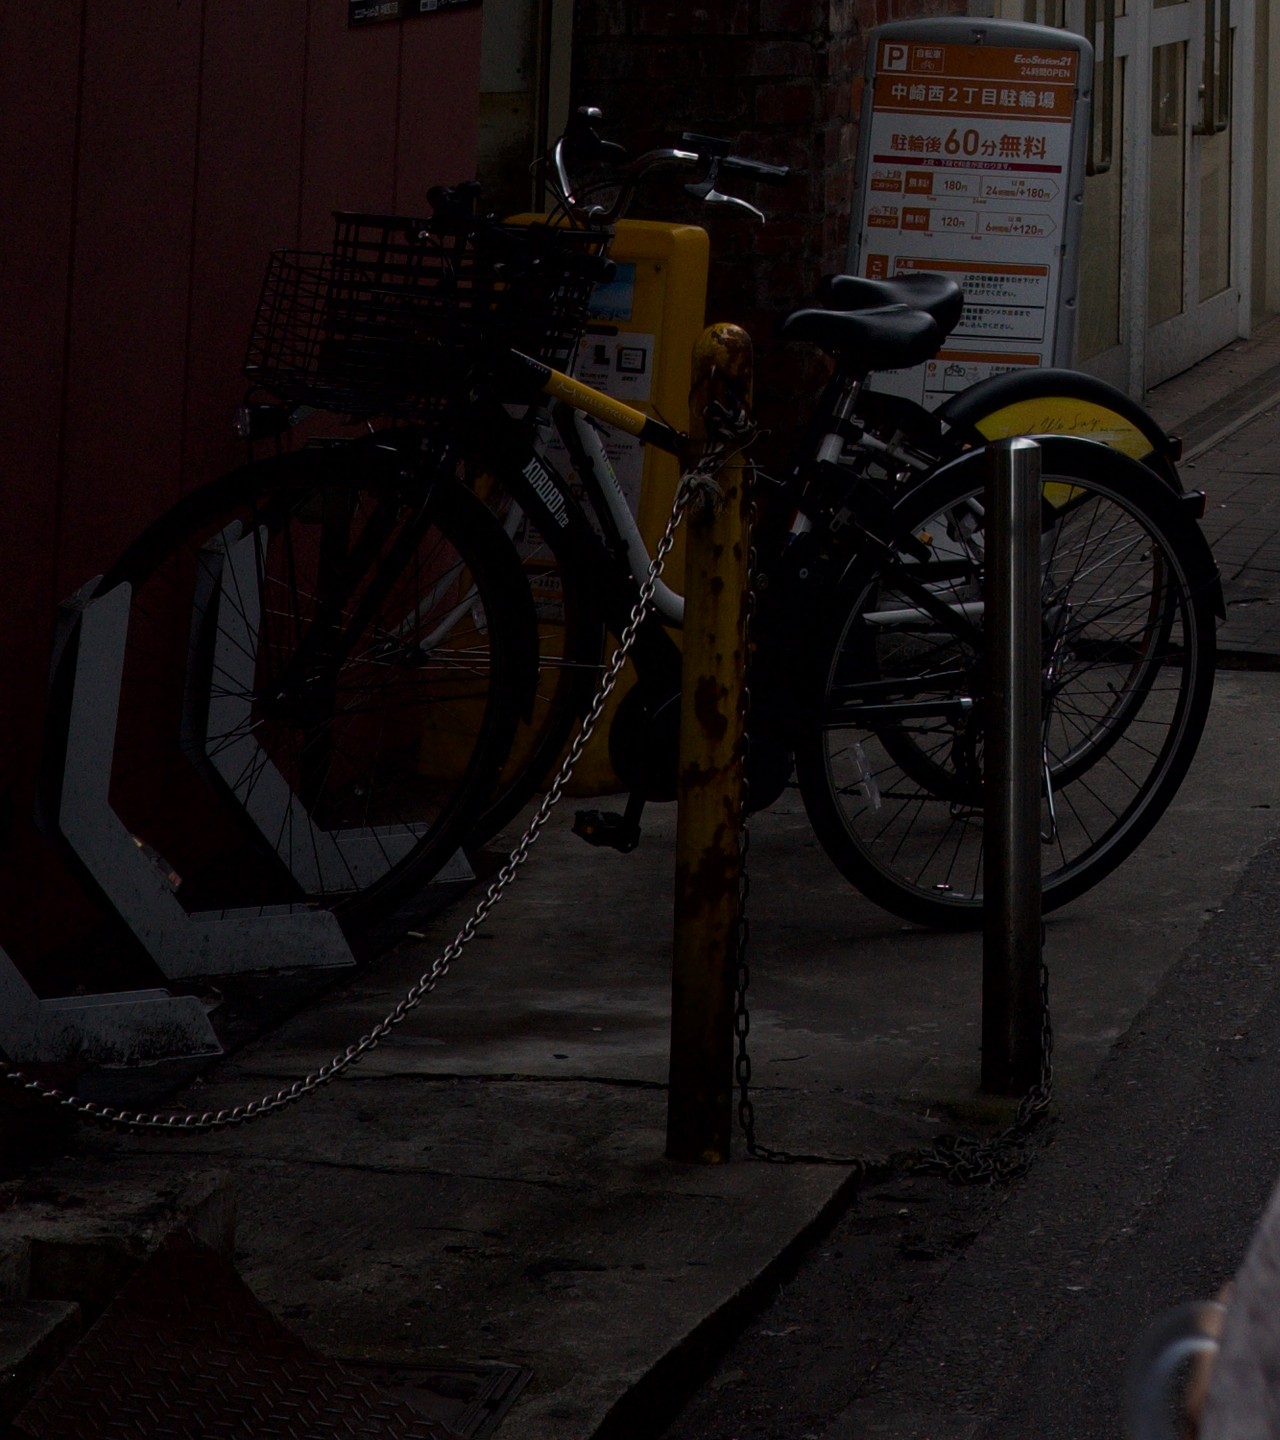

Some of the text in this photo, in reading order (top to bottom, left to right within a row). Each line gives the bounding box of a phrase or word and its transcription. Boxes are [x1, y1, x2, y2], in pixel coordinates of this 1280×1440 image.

[888, 47, 904, 67] P
[1014, 54, 1072, 66] EcoStation21
[890, 129, 1047, 160] 駐輪後60分無料
